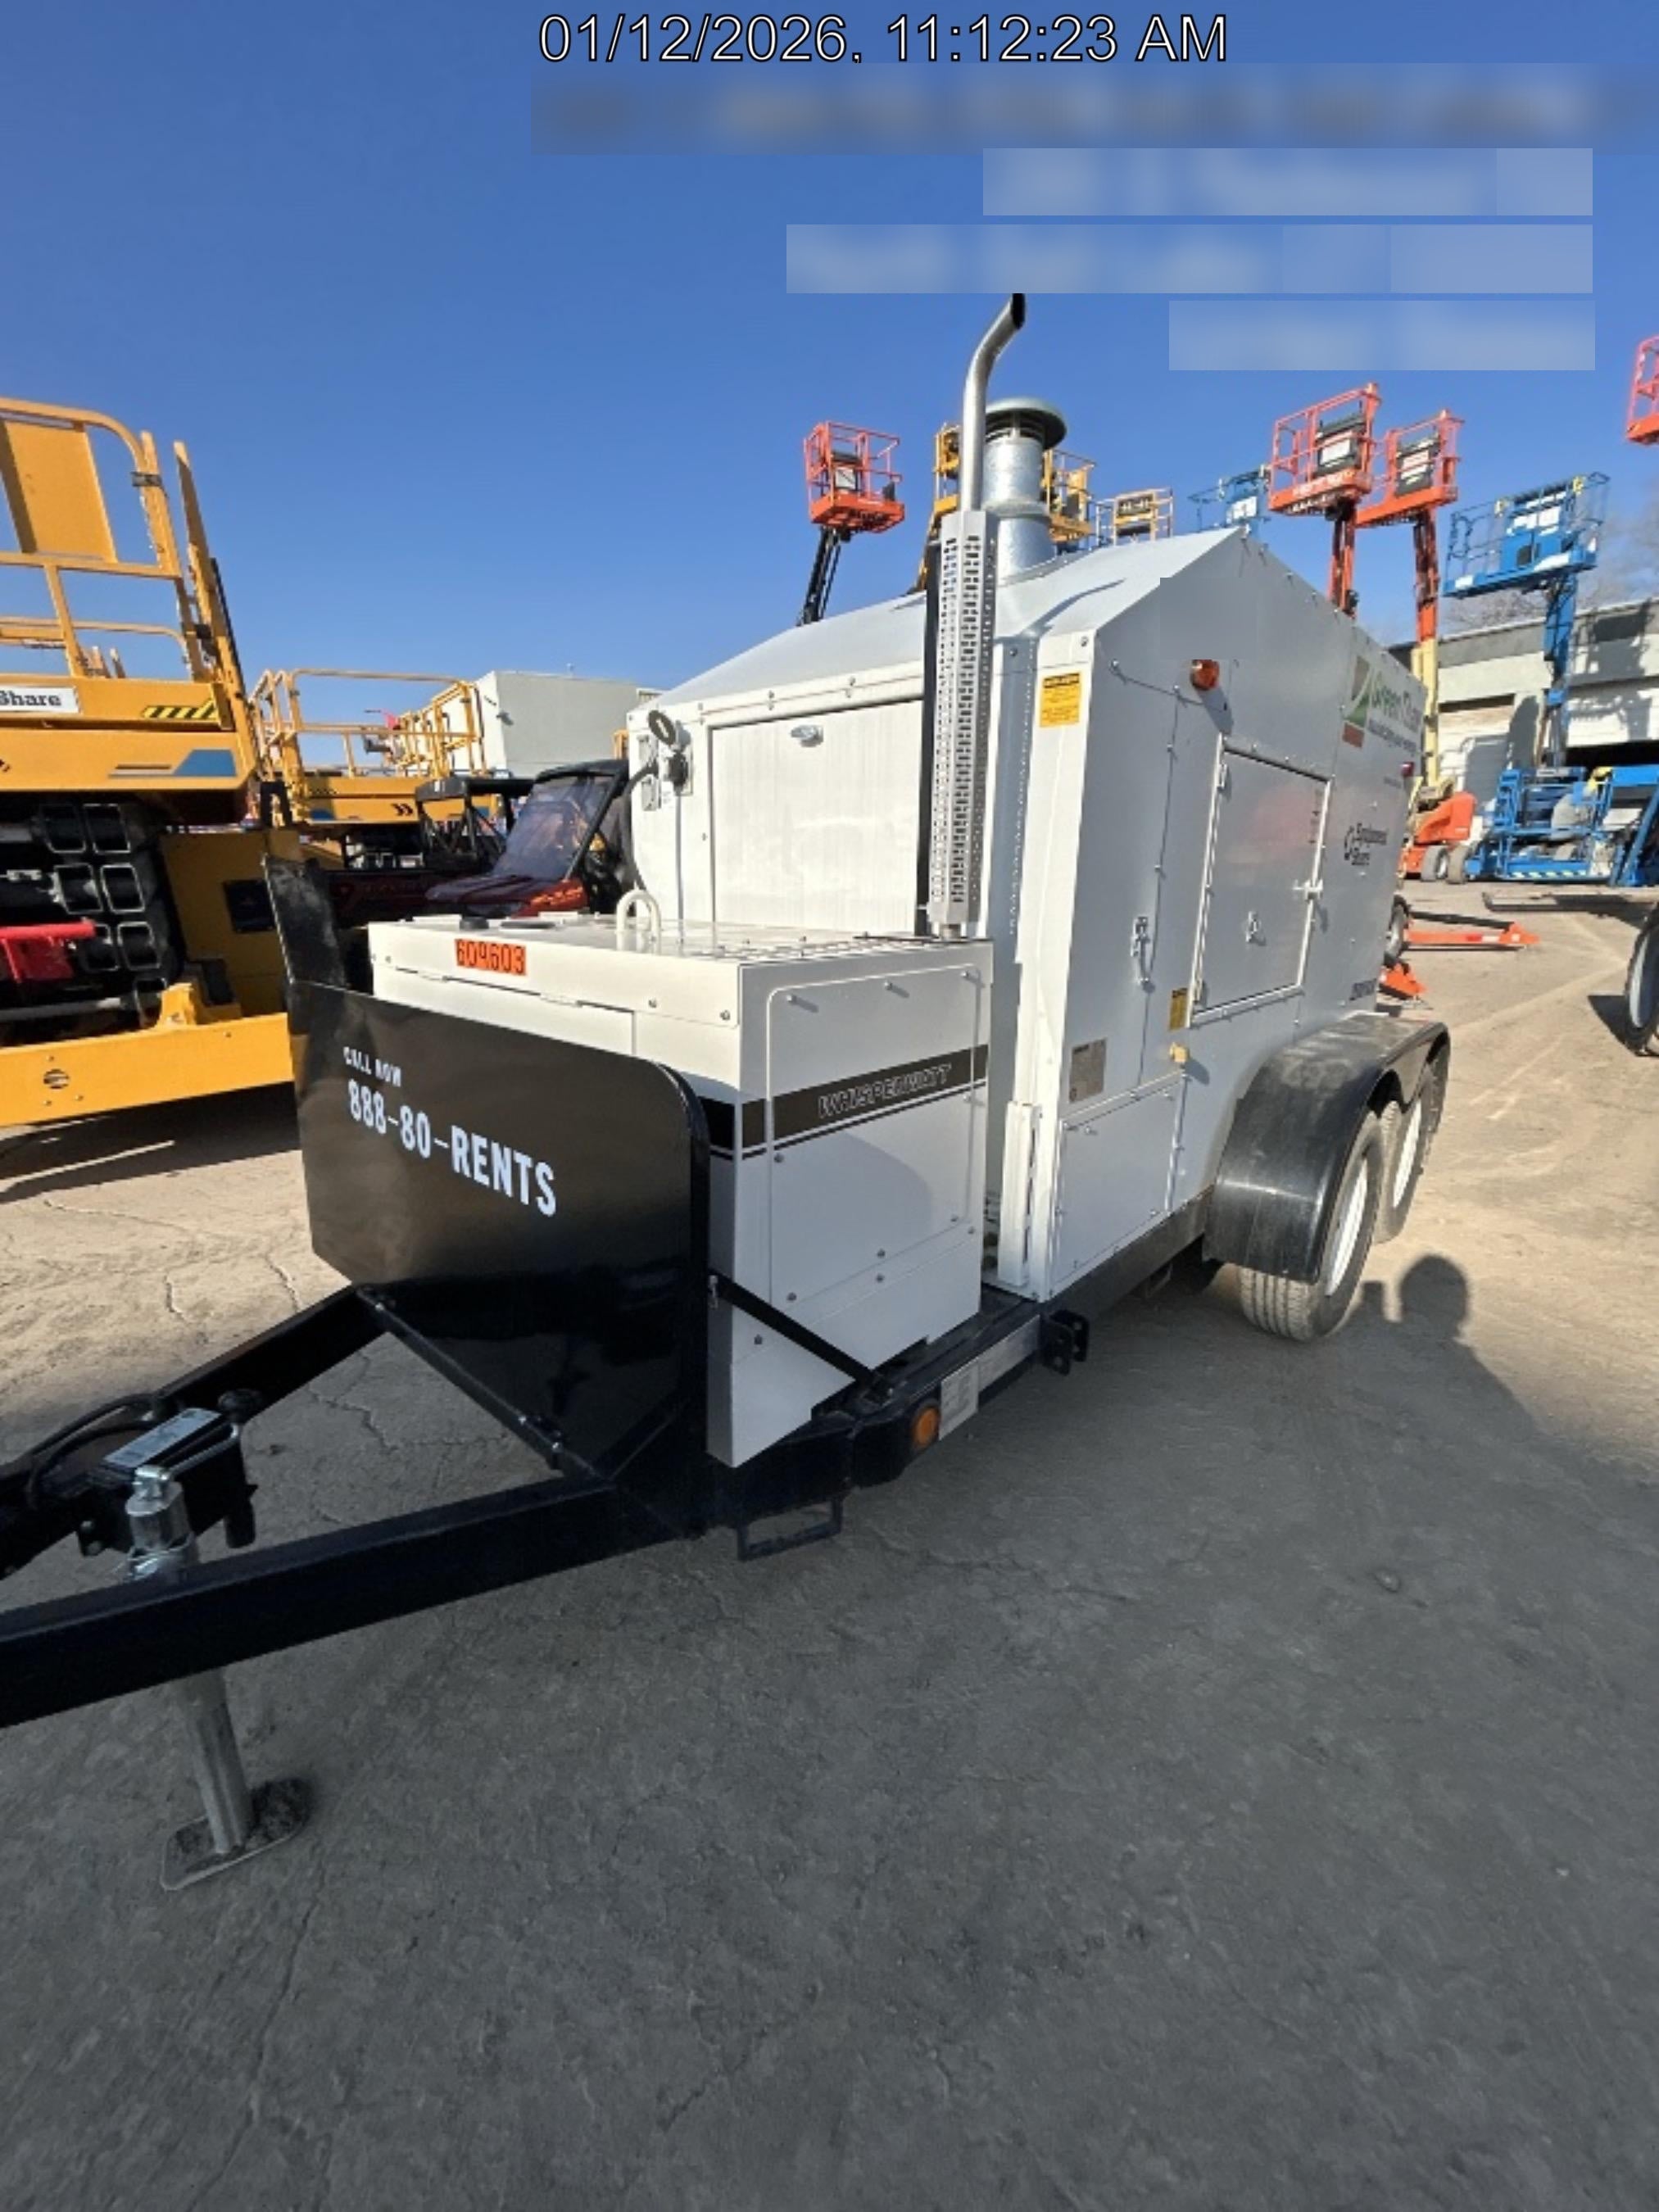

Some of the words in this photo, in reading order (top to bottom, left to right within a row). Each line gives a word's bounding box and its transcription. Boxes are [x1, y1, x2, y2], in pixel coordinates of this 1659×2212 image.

[343, 1046, 372, 1076] CALL
[375, 1058, 402, 1088] NOW
[348, 1078, 557, 1217] 888-80-RENTS
